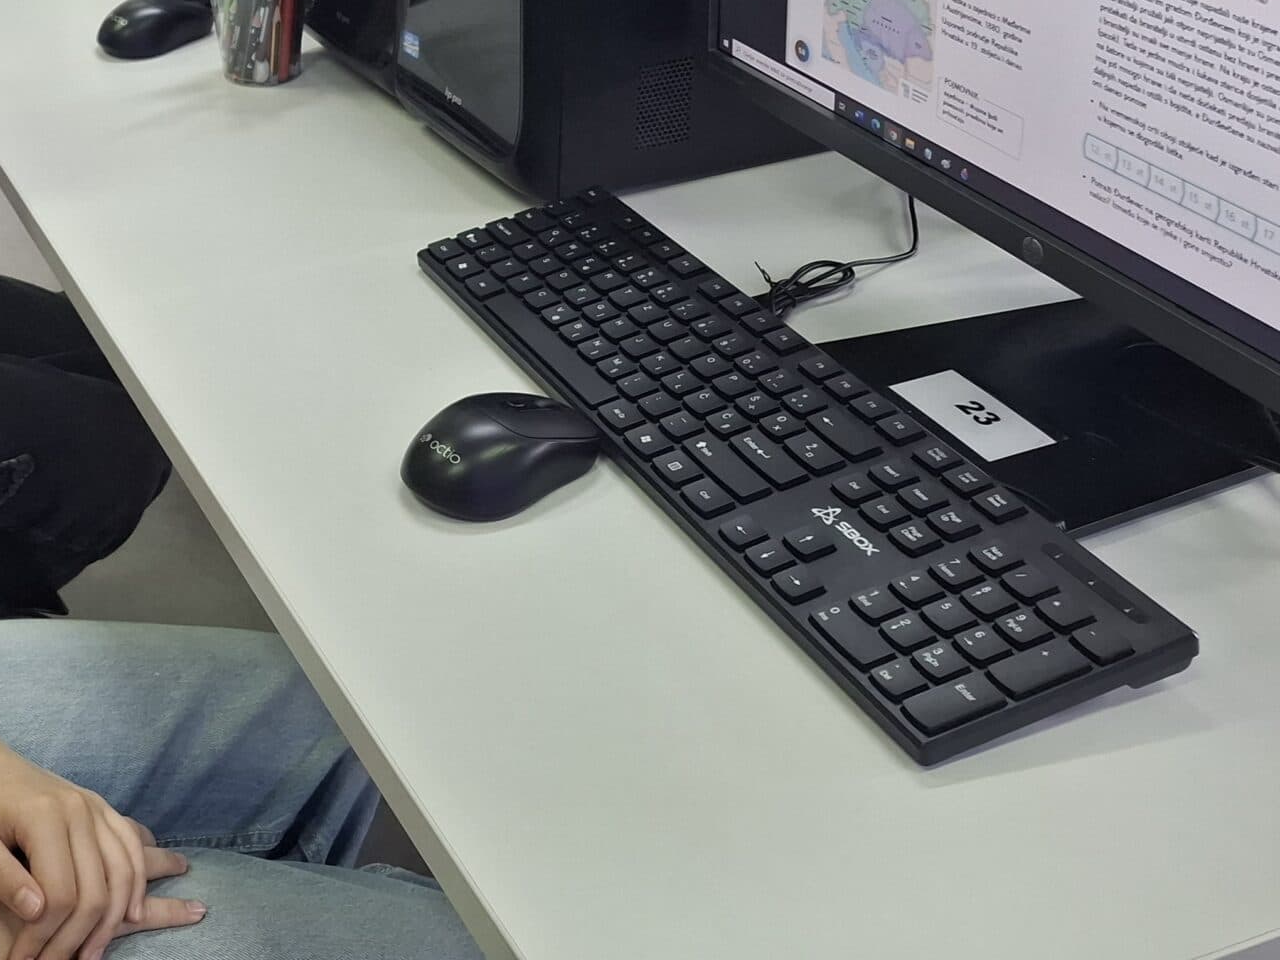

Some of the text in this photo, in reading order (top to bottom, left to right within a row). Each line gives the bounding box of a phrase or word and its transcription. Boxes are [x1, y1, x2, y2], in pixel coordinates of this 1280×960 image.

[954, 400, 1001, 426] 23
[430, 440, 460, 464] octio
[954, 684, 976, 701] Enter
